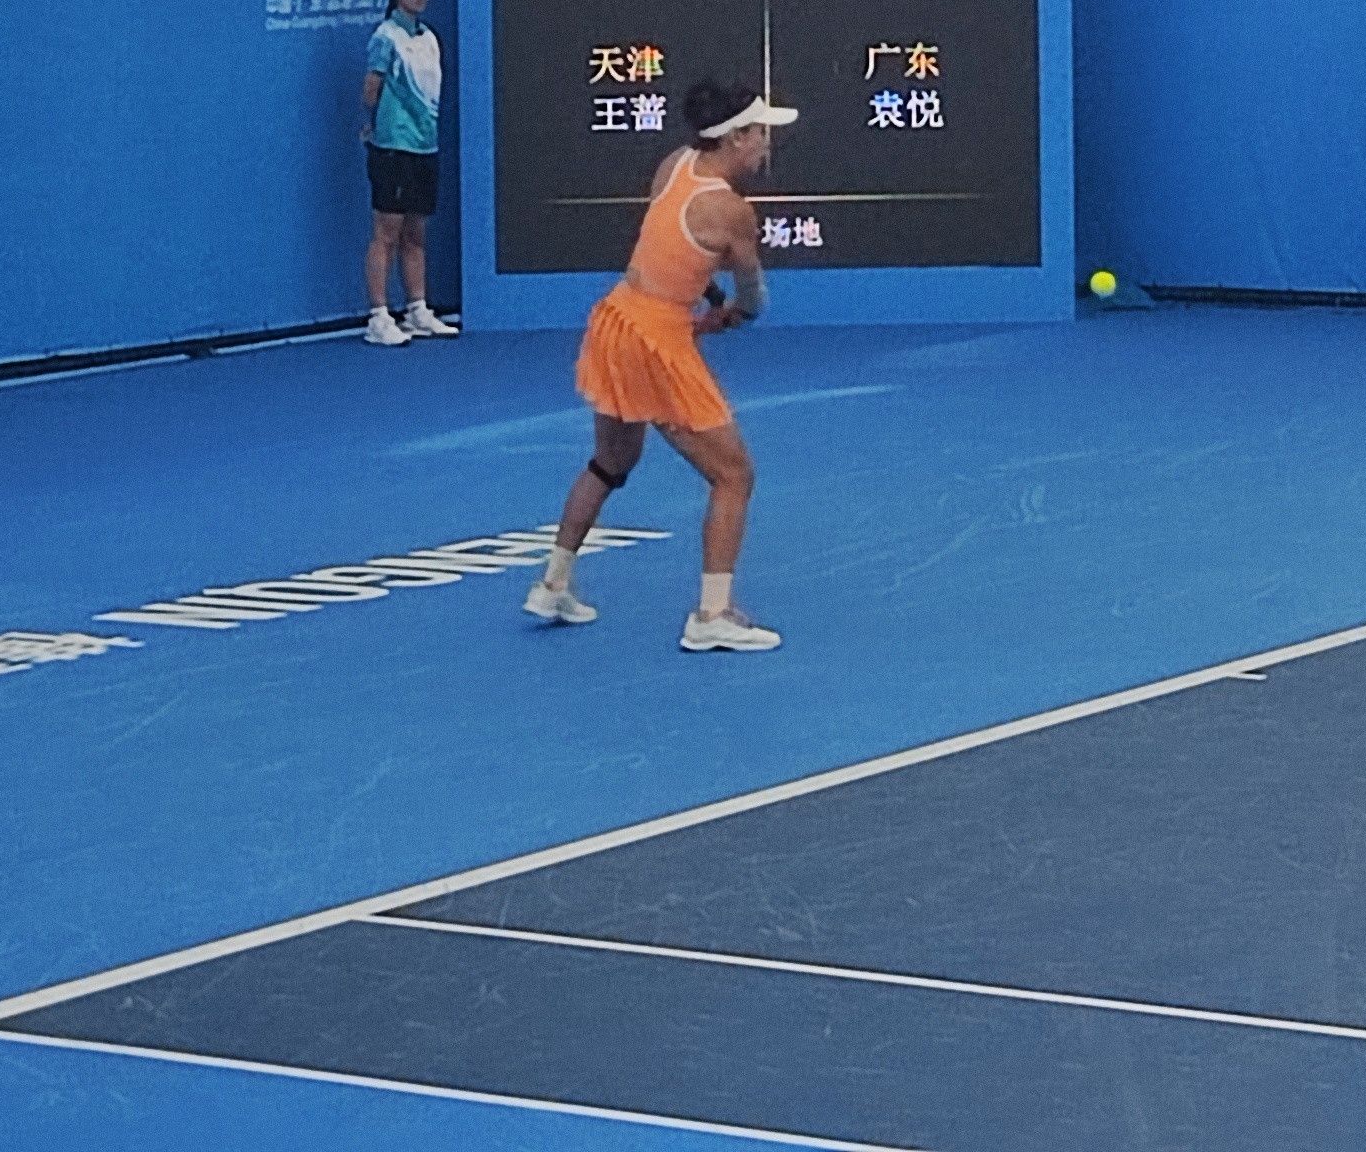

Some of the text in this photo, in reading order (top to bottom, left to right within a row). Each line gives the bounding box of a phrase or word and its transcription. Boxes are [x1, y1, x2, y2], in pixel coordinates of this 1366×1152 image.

[589, 45, 665, 84] 天津
[864, 41, 940, 80] 广东
[591, 93, 667, 131] 王蔷
[867, 89, 944, 128] 袁悦
